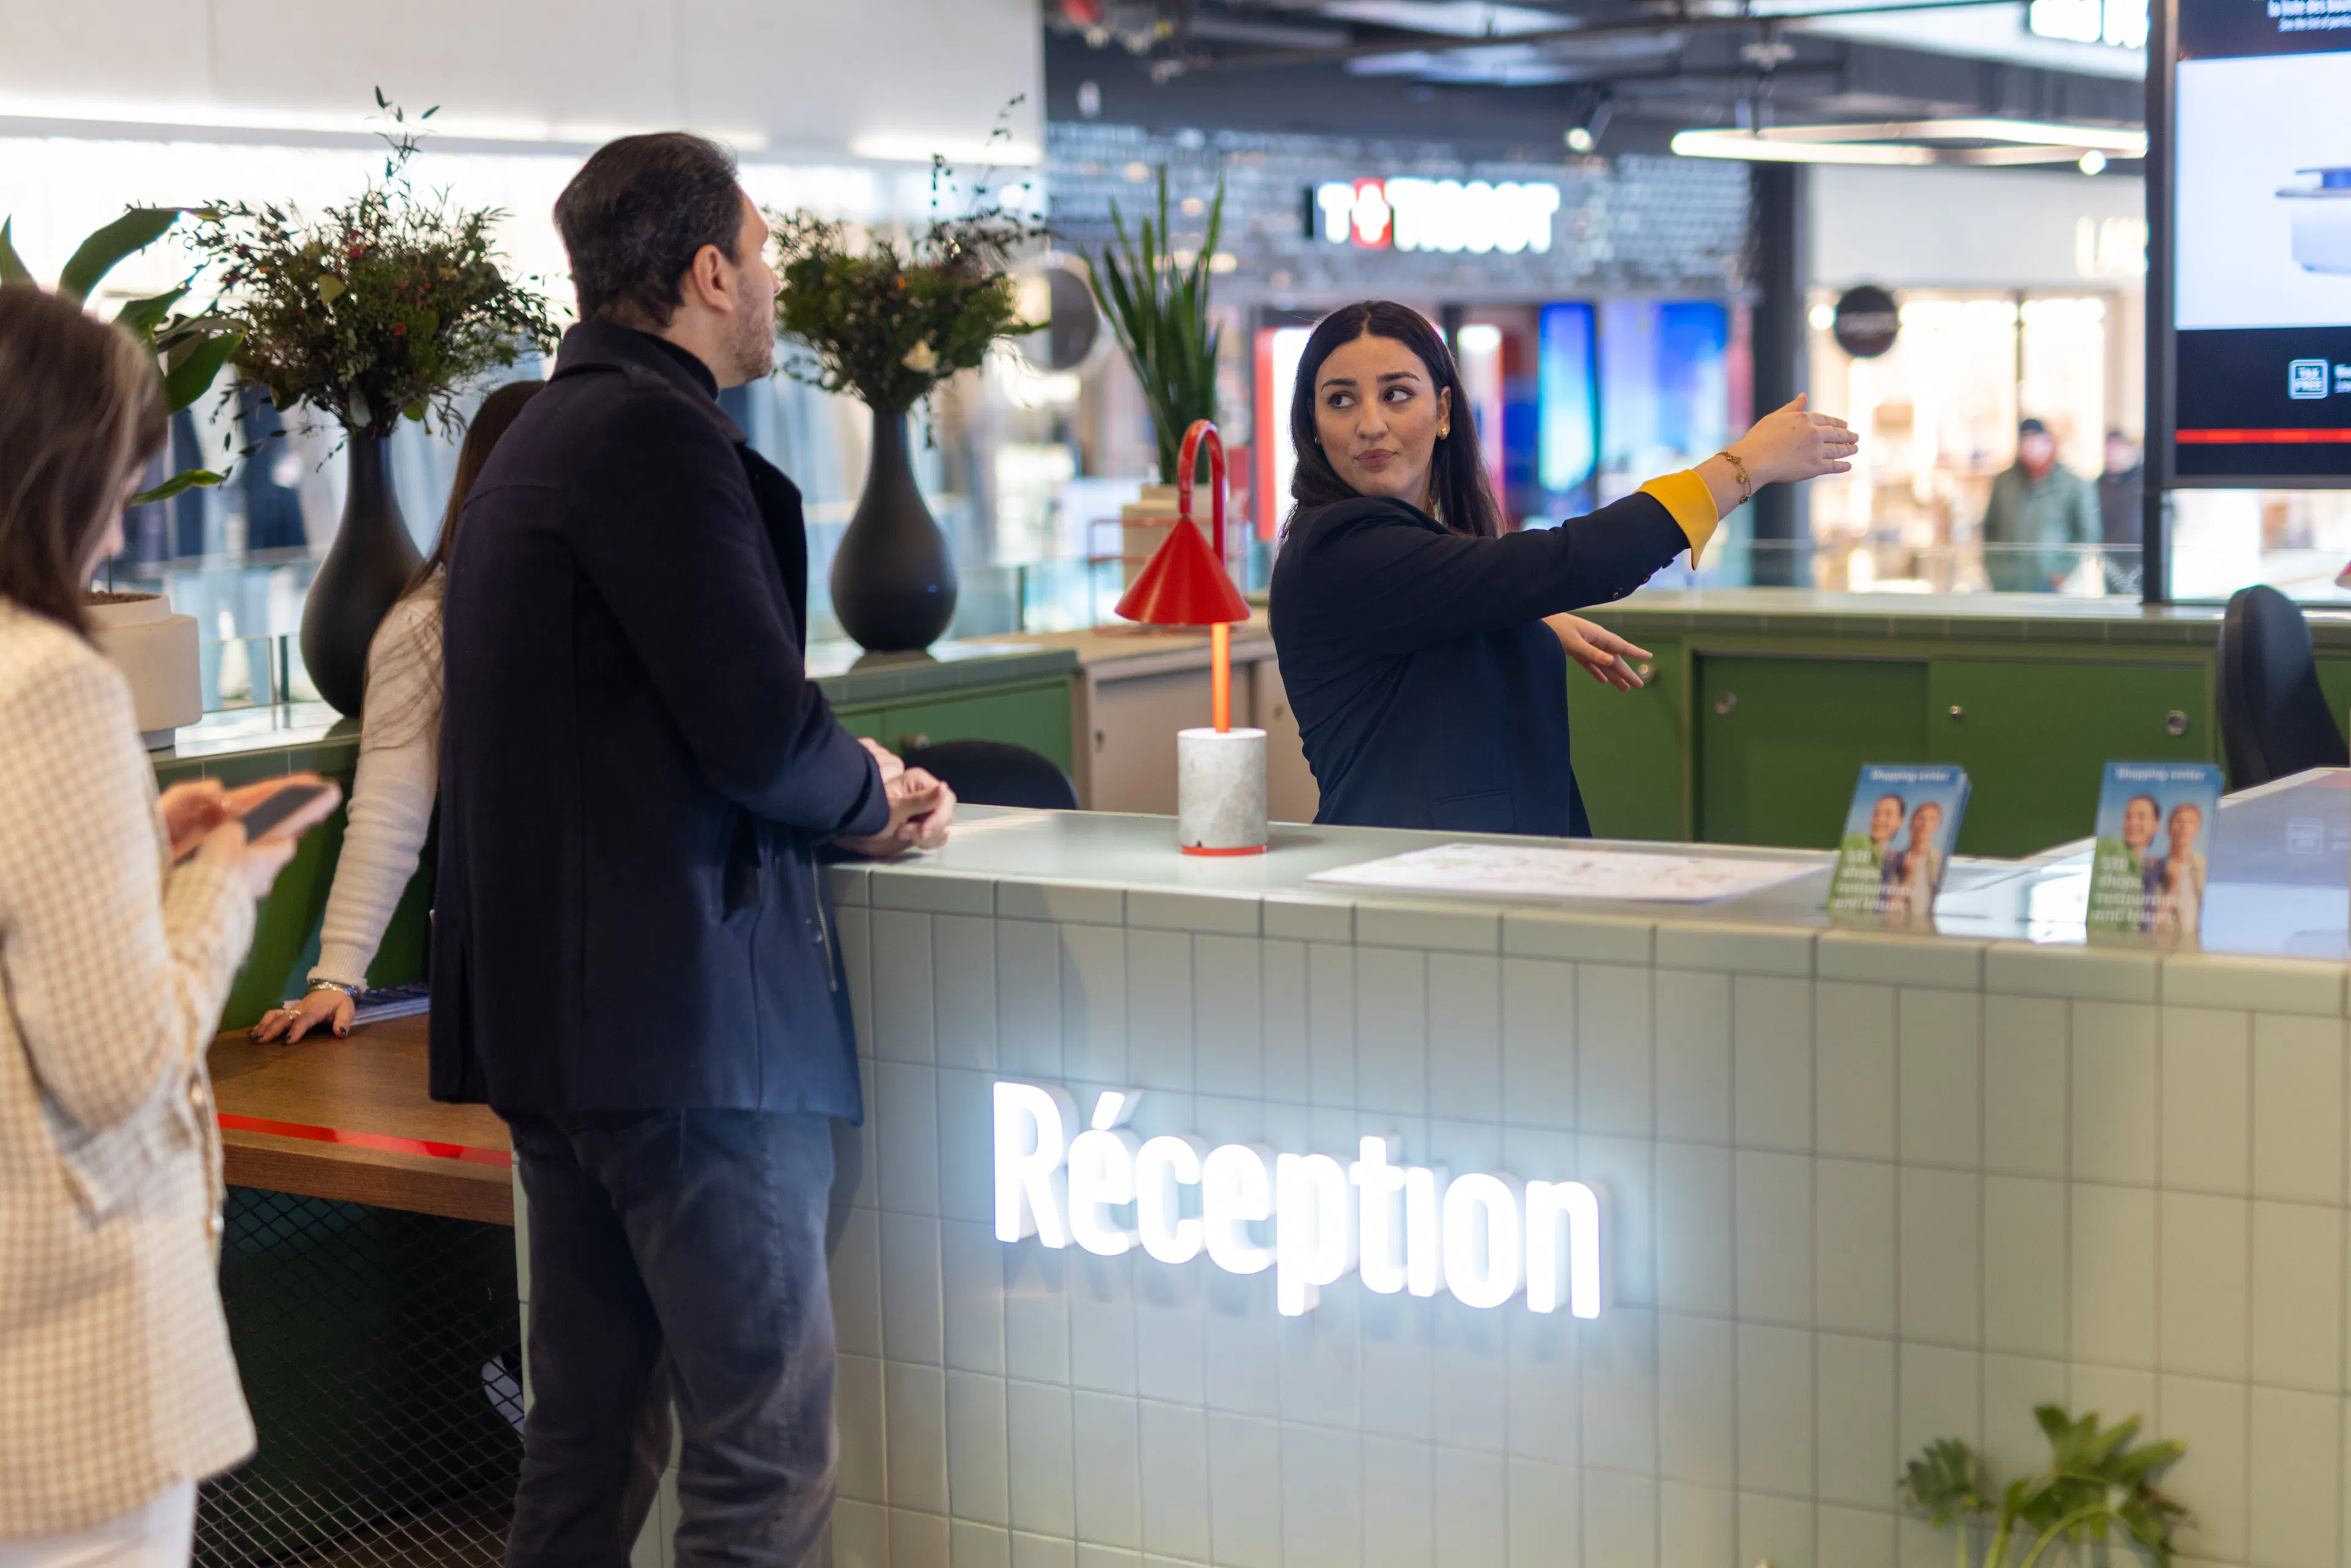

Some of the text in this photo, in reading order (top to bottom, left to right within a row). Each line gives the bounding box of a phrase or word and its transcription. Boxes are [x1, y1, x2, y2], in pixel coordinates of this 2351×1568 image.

[1871, 769, 1916, 782] Shopping
[2118, 767, 2169, 782] Shopping
[992, 1081, 1605, 1320] Réception
